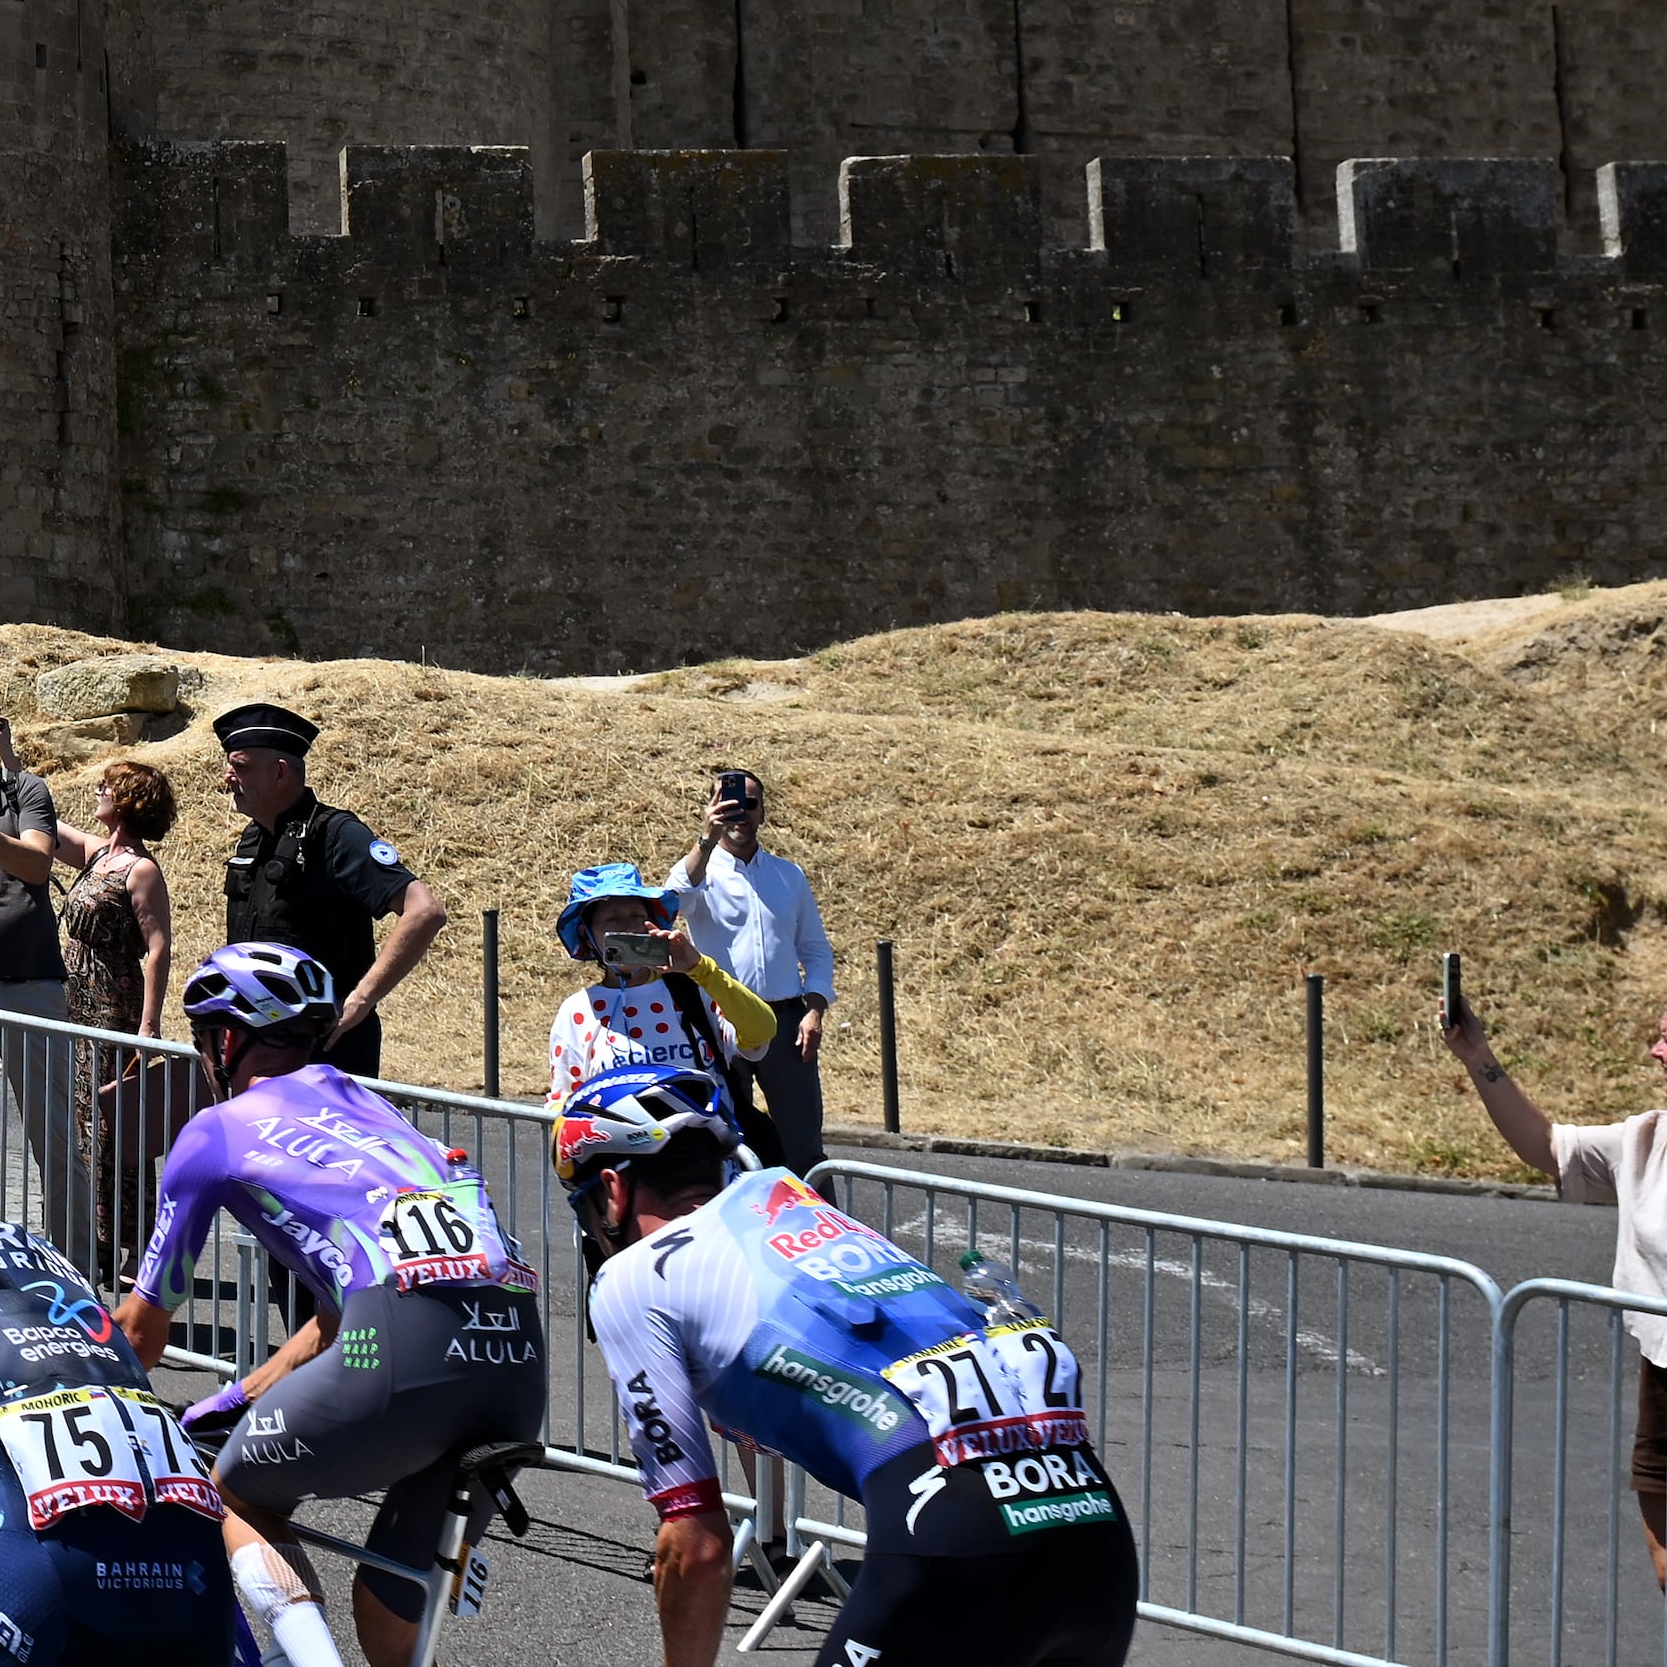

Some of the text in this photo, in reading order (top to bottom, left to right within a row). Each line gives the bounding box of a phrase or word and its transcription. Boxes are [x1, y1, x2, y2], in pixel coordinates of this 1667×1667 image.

[249, 1115, 365, 1183] ALULA
[136, 1191, 180, 1287] CADEX
[261, 1209, 356, 1289] Jayco
[380, 1199, 475, 1262] 116
[768, 1208, 843, 1261] Red
[397, 1258, 481, 1289] VELUX
[2, 1325, 82, 1349] Bapco
[19, 1338, 120, 1363] energies
[443, 1336, 539, 1365] ALULA
[21, 1390, 82, 1412] MOHORIC
[763, 1346, 900, 1431] hansgrohe
[916, 1349, 1006, 1426] 27
[627, 1370, 686, 1467] BORA
[19, 1406, 114, 1482] 75
[240, 1436, 317, 1467] ALULA
[937, 1421, 1029, 1466] VELUX
[982, 1451, 1103, 1500] BORA
[32, 1482, 138, 1519] VELUX
[1003, 1493, 1113, 1528] hansgrohe
[95, 1561, 184, 1579] BAHRAIN
[95, 1576, 186, 1591] VICTORIOUS
[463, 1556, 488, 1613] 116
